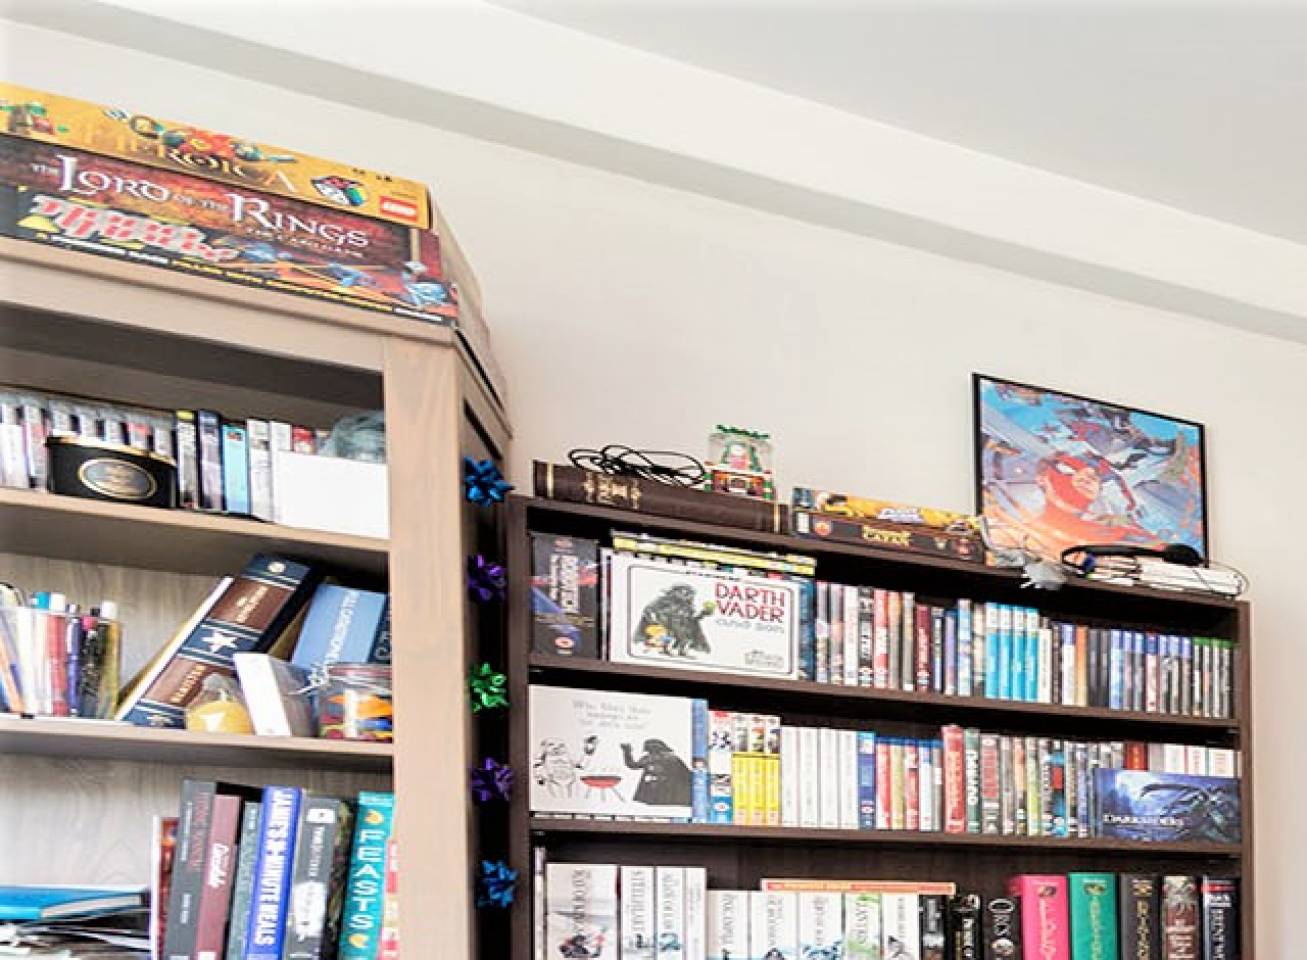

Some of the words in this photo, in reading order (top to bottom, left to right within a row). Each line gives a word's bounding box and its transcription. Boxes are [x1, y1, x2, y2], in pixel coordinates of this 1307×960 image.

[57, 154, 172, 204] LORD
[227, 192, 371, 249] RINGS
[715, 582, 786, 608] DARTH
[715, 599, 787, 624] VADER
[349, 829, 386, 931] FEASTS
[988, 898, 1015, 937] ORCS
